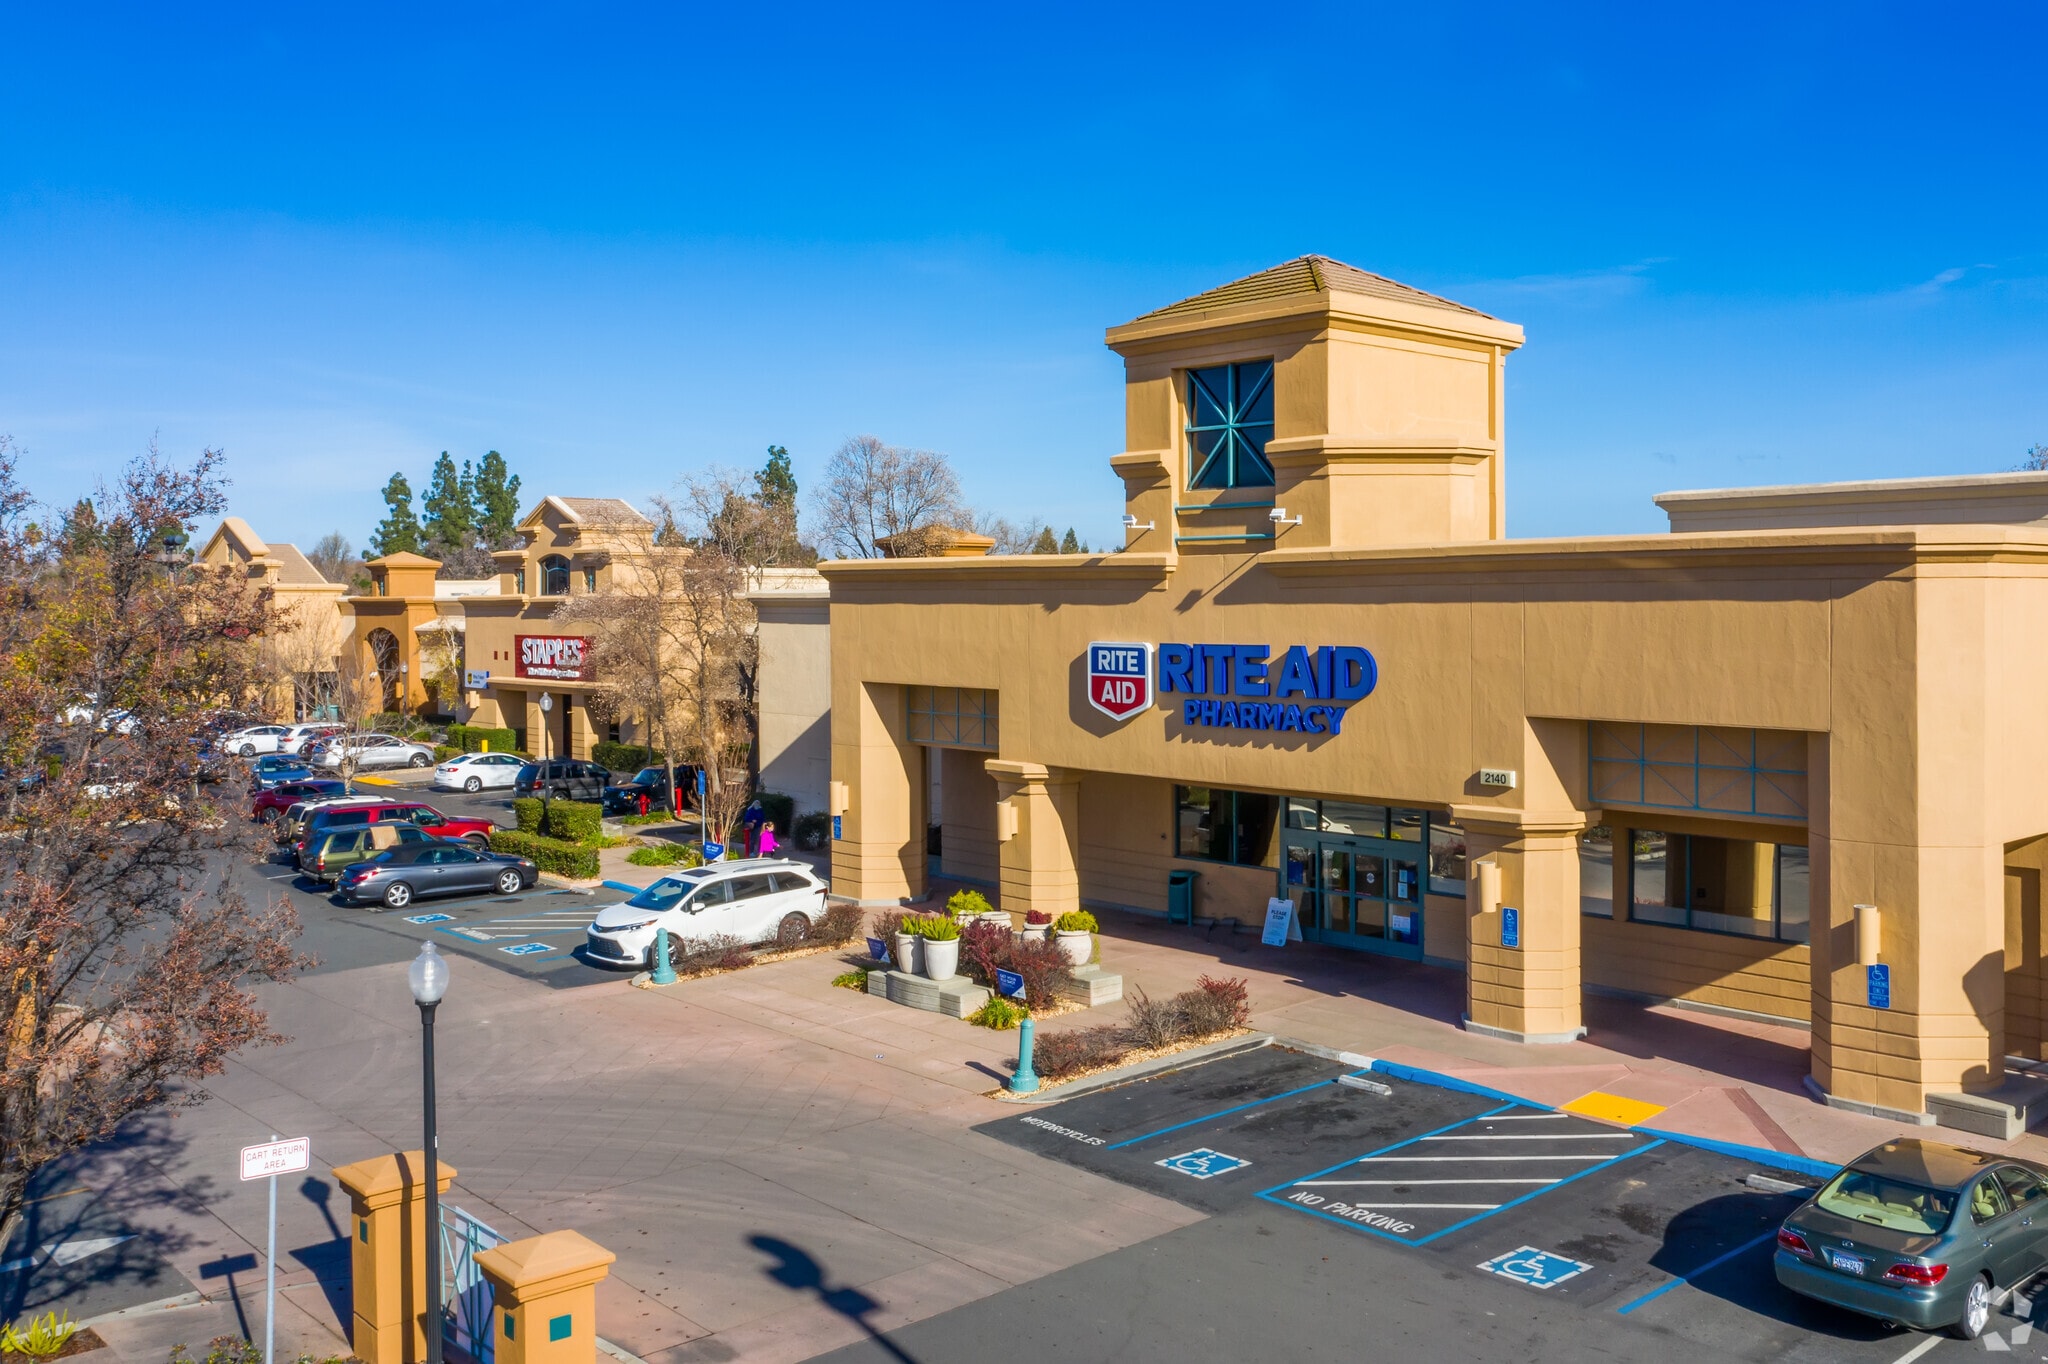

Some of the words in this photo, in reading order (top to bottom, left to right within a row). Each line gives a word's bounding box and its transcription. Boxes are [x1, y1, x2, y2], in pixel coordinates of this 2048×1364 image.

[521, 638, 581, 666] STAPLES
[1098, 650, 1139, 672] RITE
[1159, 643, 1270, 696] RITE
[1276, 645, 1378, 700] AID
[1101, 680, 1137, 704] AID
[1184, 699, 1346, 735] PHARMACY
[1485, 773, 1507, 784] 2140
[1020, 1116, 1106, 1146] MOTORCYCLES
[246, 1150, 268, 1162] CART
[272, 1144, 305, 1157] RETURN
[264, 1159, 286, 1170] AREA
[1288, 1191, 1326, 1205] NO
[1322, 1202, 1415, 1233] PARKING
